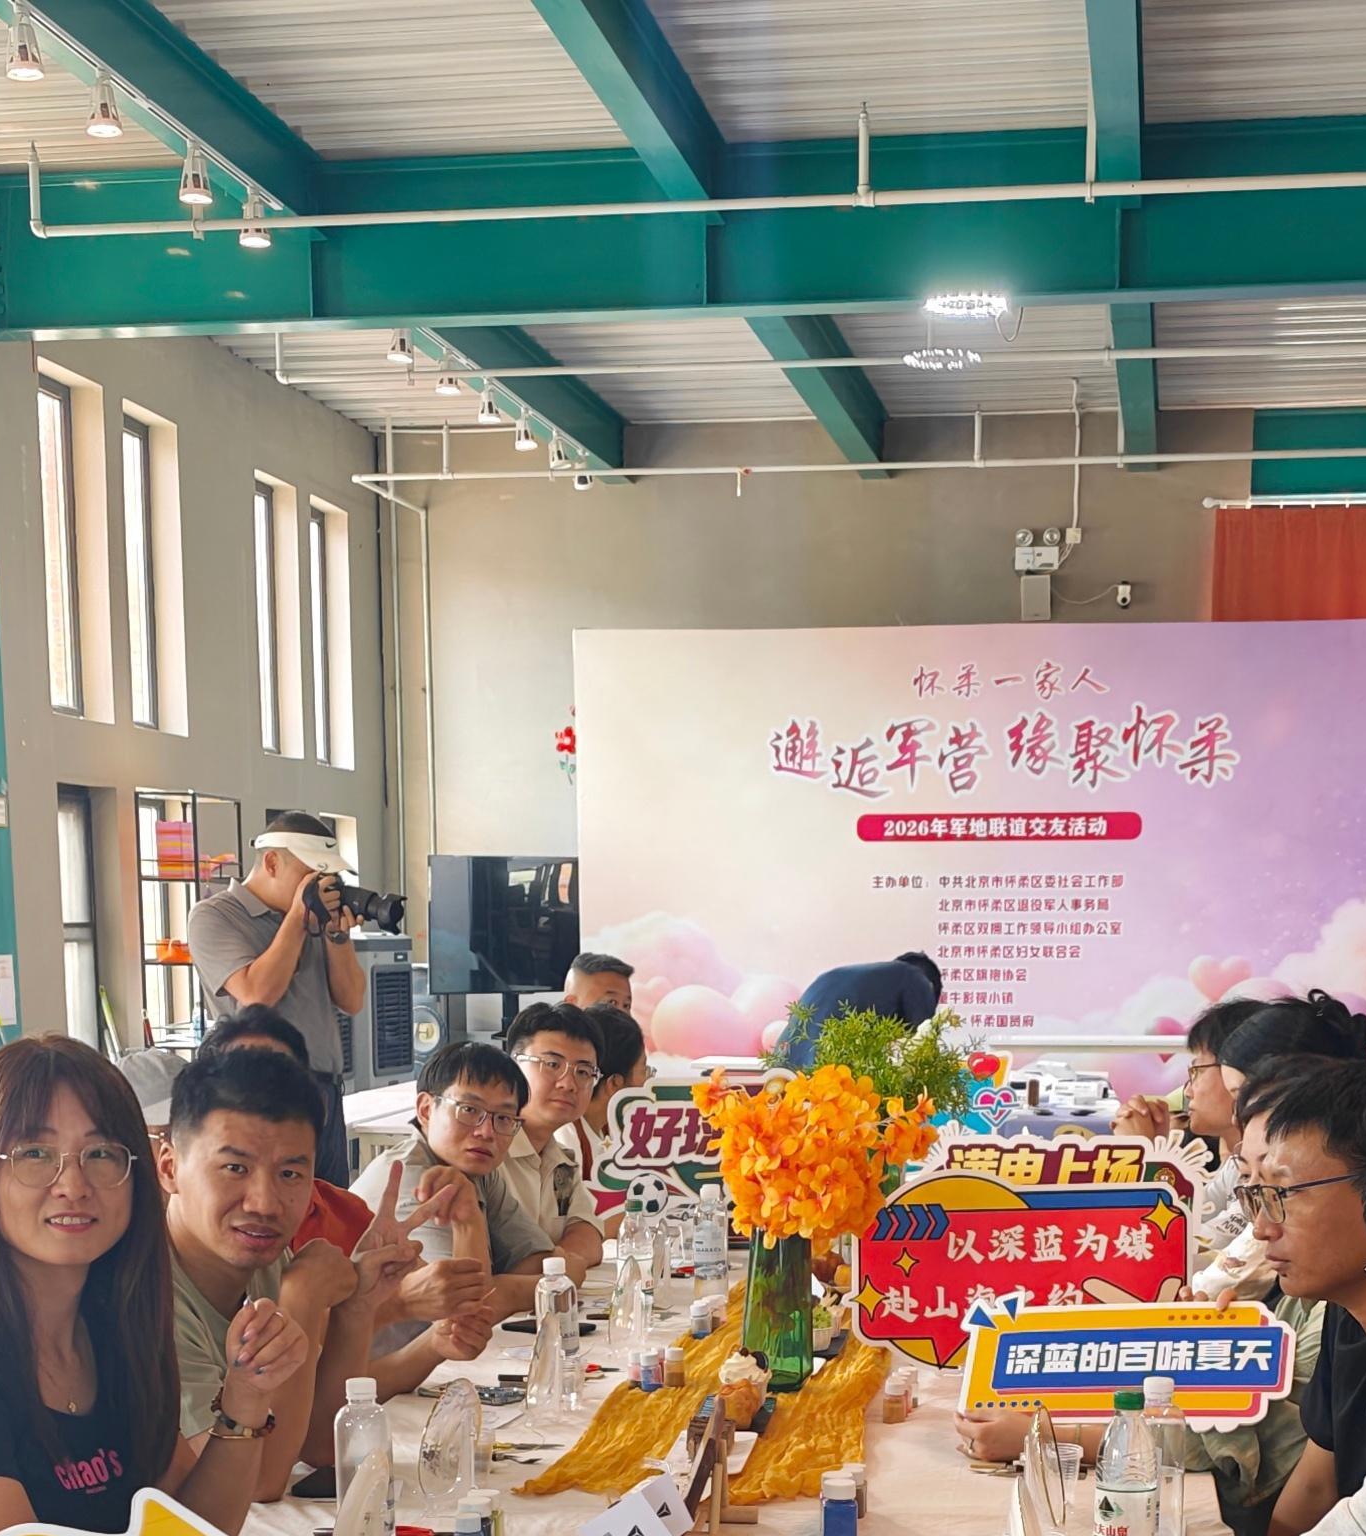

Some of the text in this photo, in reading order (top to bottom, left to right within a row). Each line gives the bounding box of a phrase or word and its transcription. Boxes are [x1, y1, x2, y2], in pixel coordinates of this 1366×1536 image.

[912, 660, 1110, 700] 怀柔一家人
[769, 704, 1239, 799] 邂逅军营 缘聚怀柔
[882, 816, 1108, 839] 2026年军地联谊交友活动
[938, 898, 1110, 913] 北京市怀柔区退役军人事务局
[936, 945, 1081, 959] 北京市怀柔区妇女联合会
[946, 1222, 1156, 1264] 以深蓝为媒
[1004, 1338, 1274, 1375] 深蓝的百味夏天
